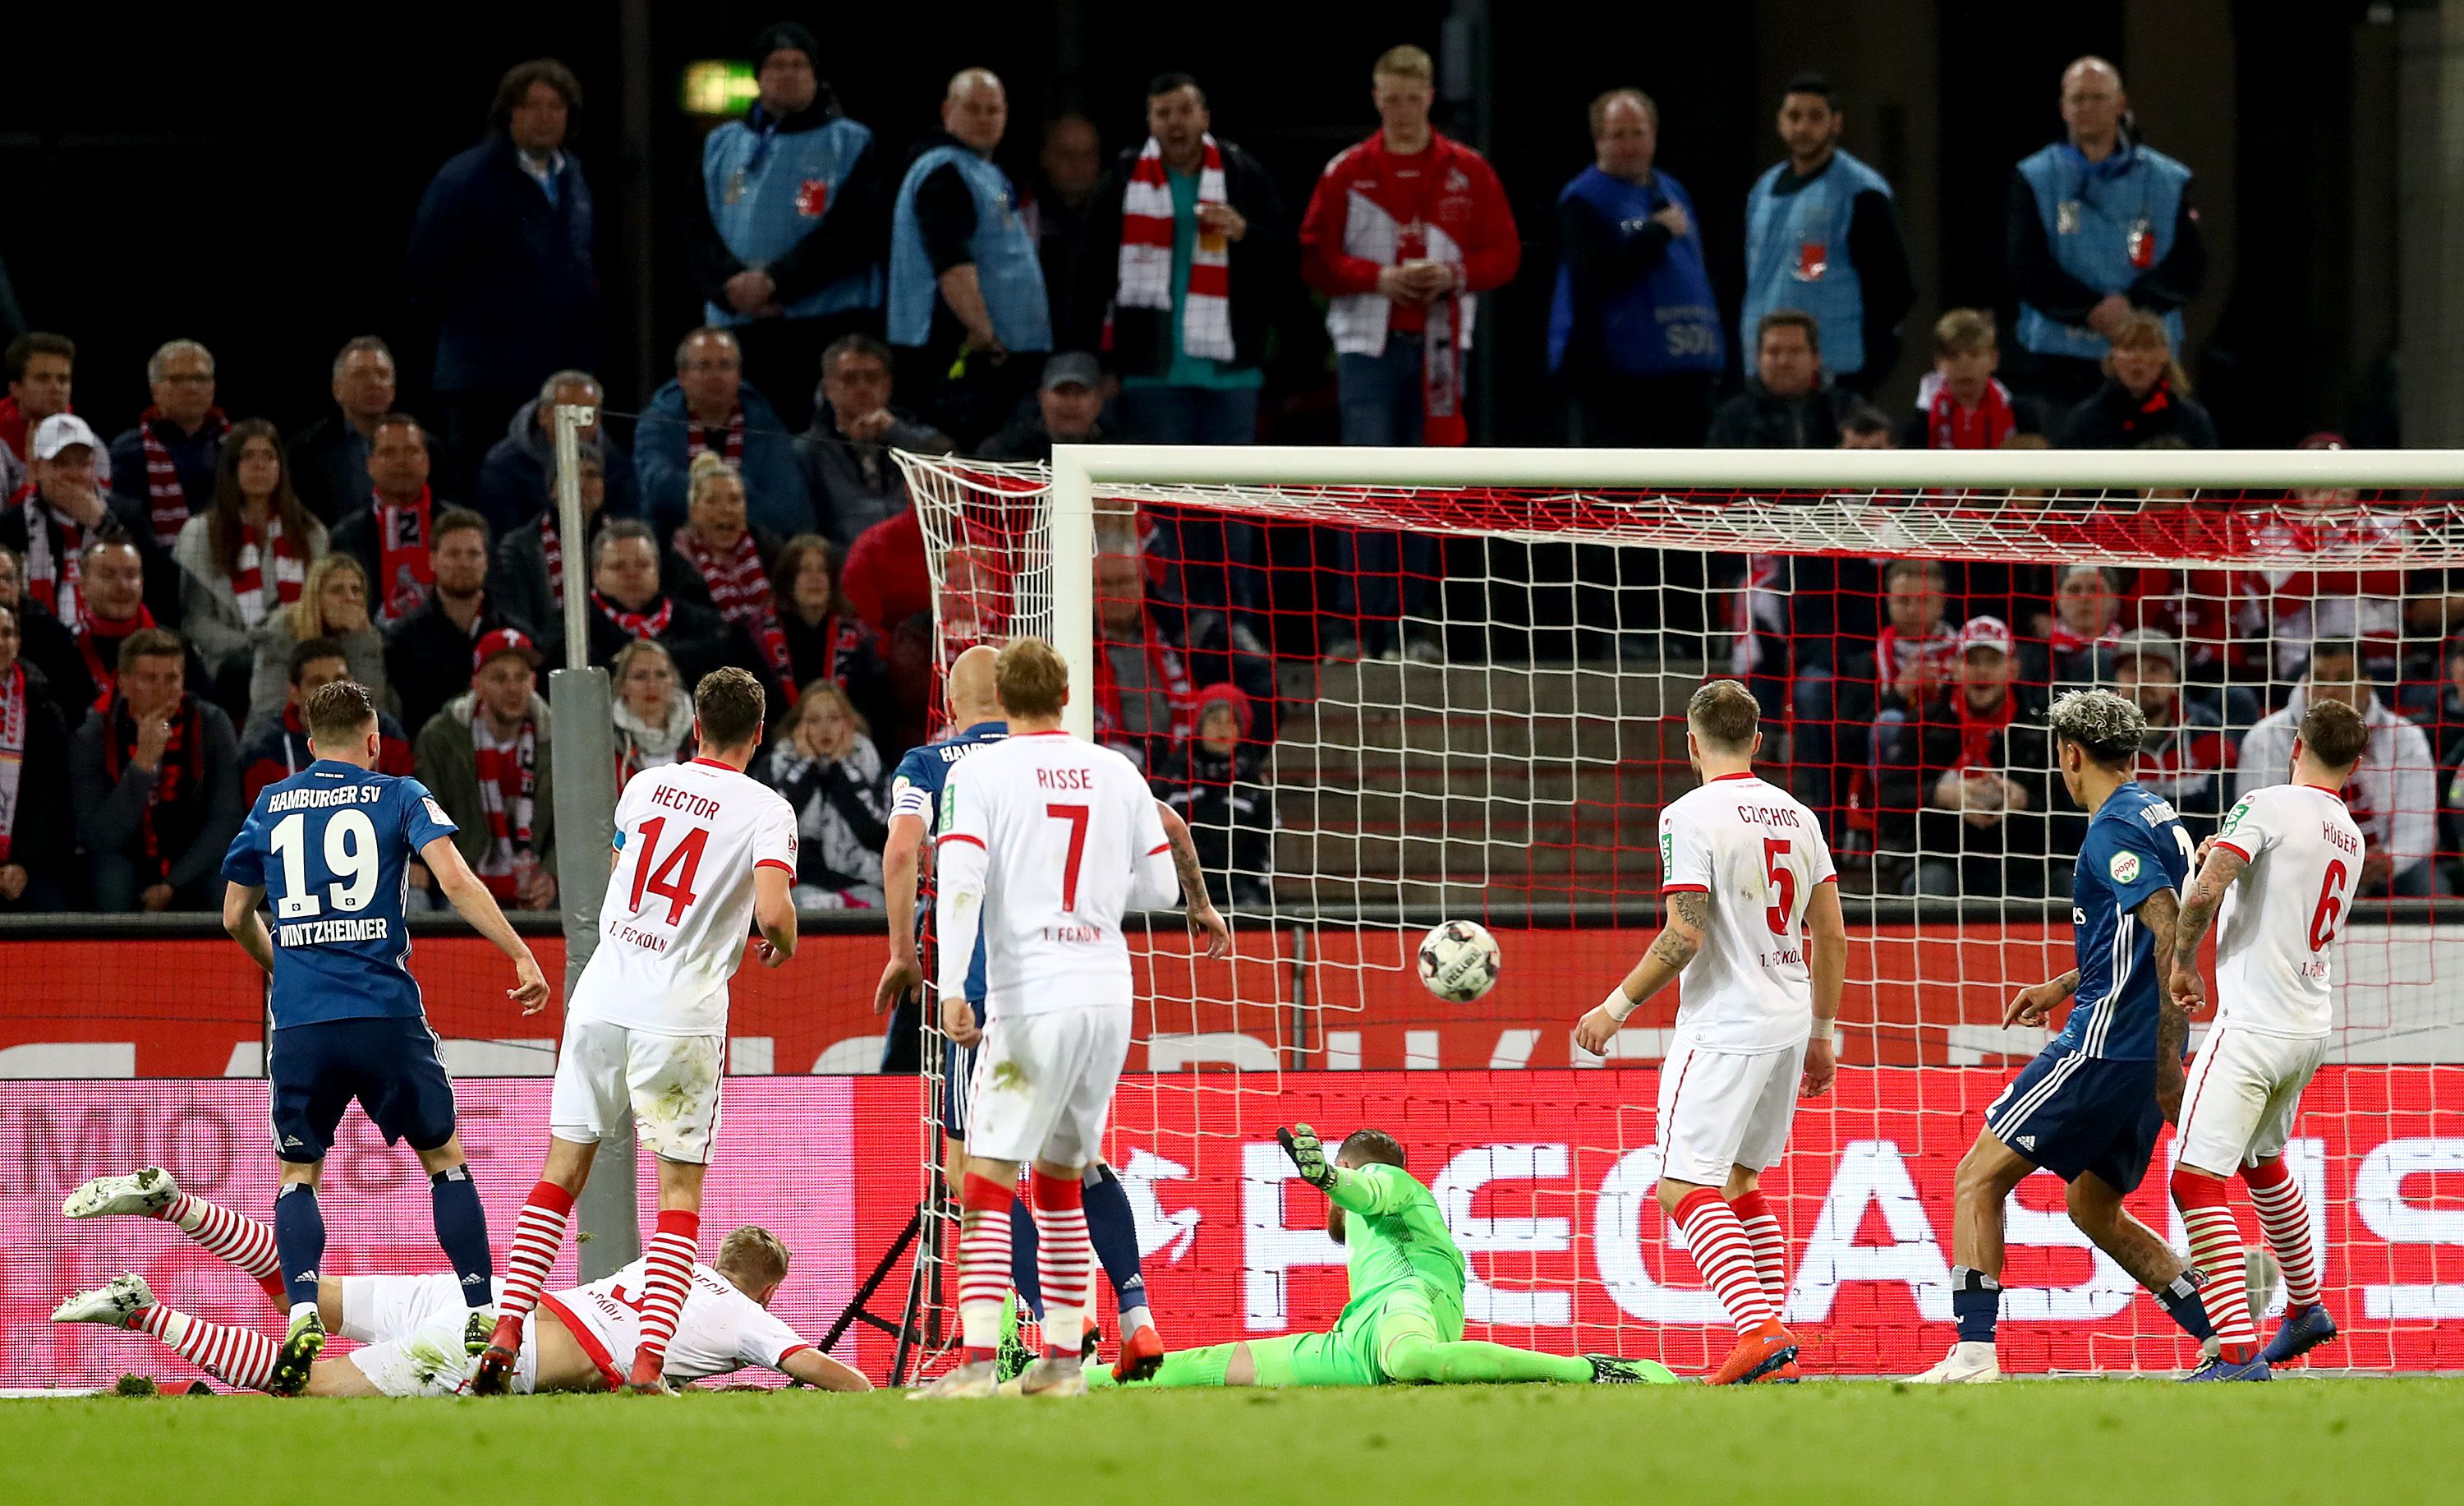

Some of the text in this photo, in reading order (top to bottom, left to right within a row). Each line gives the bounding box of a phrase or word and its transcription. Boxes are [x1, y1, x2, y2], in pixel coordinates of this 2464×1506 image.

[1037, 768, 1092, 790] RISSE
[268, 785, 381, 813] HAMBURGER SV
[651, 785, 720, 821] HECTOR
[1737, 805, 1800, 828] CZICHOS
[2221, 804, 2246, 838] DEVK
[1663, 836, 1671, 877] DEVK
[2322, 821, 2358, 857] HÖGER
[270, 808, 379, 919] 19
[629, 816, 710, 928] 14
[1046, 804, 1089, 912] 7
[2113, 859, 2136, 878] popp
[1763, 837, 1795, 936] 5
[2309, 859, 2347, 953] 6
[279, 917, 388, 947] WINTZHEIMER
[609, 920, 668, 954] 1. FC KÖLN
[1760, 953, 1769, 967] 1.
[1781, 946, 1802, 965] KÖL
